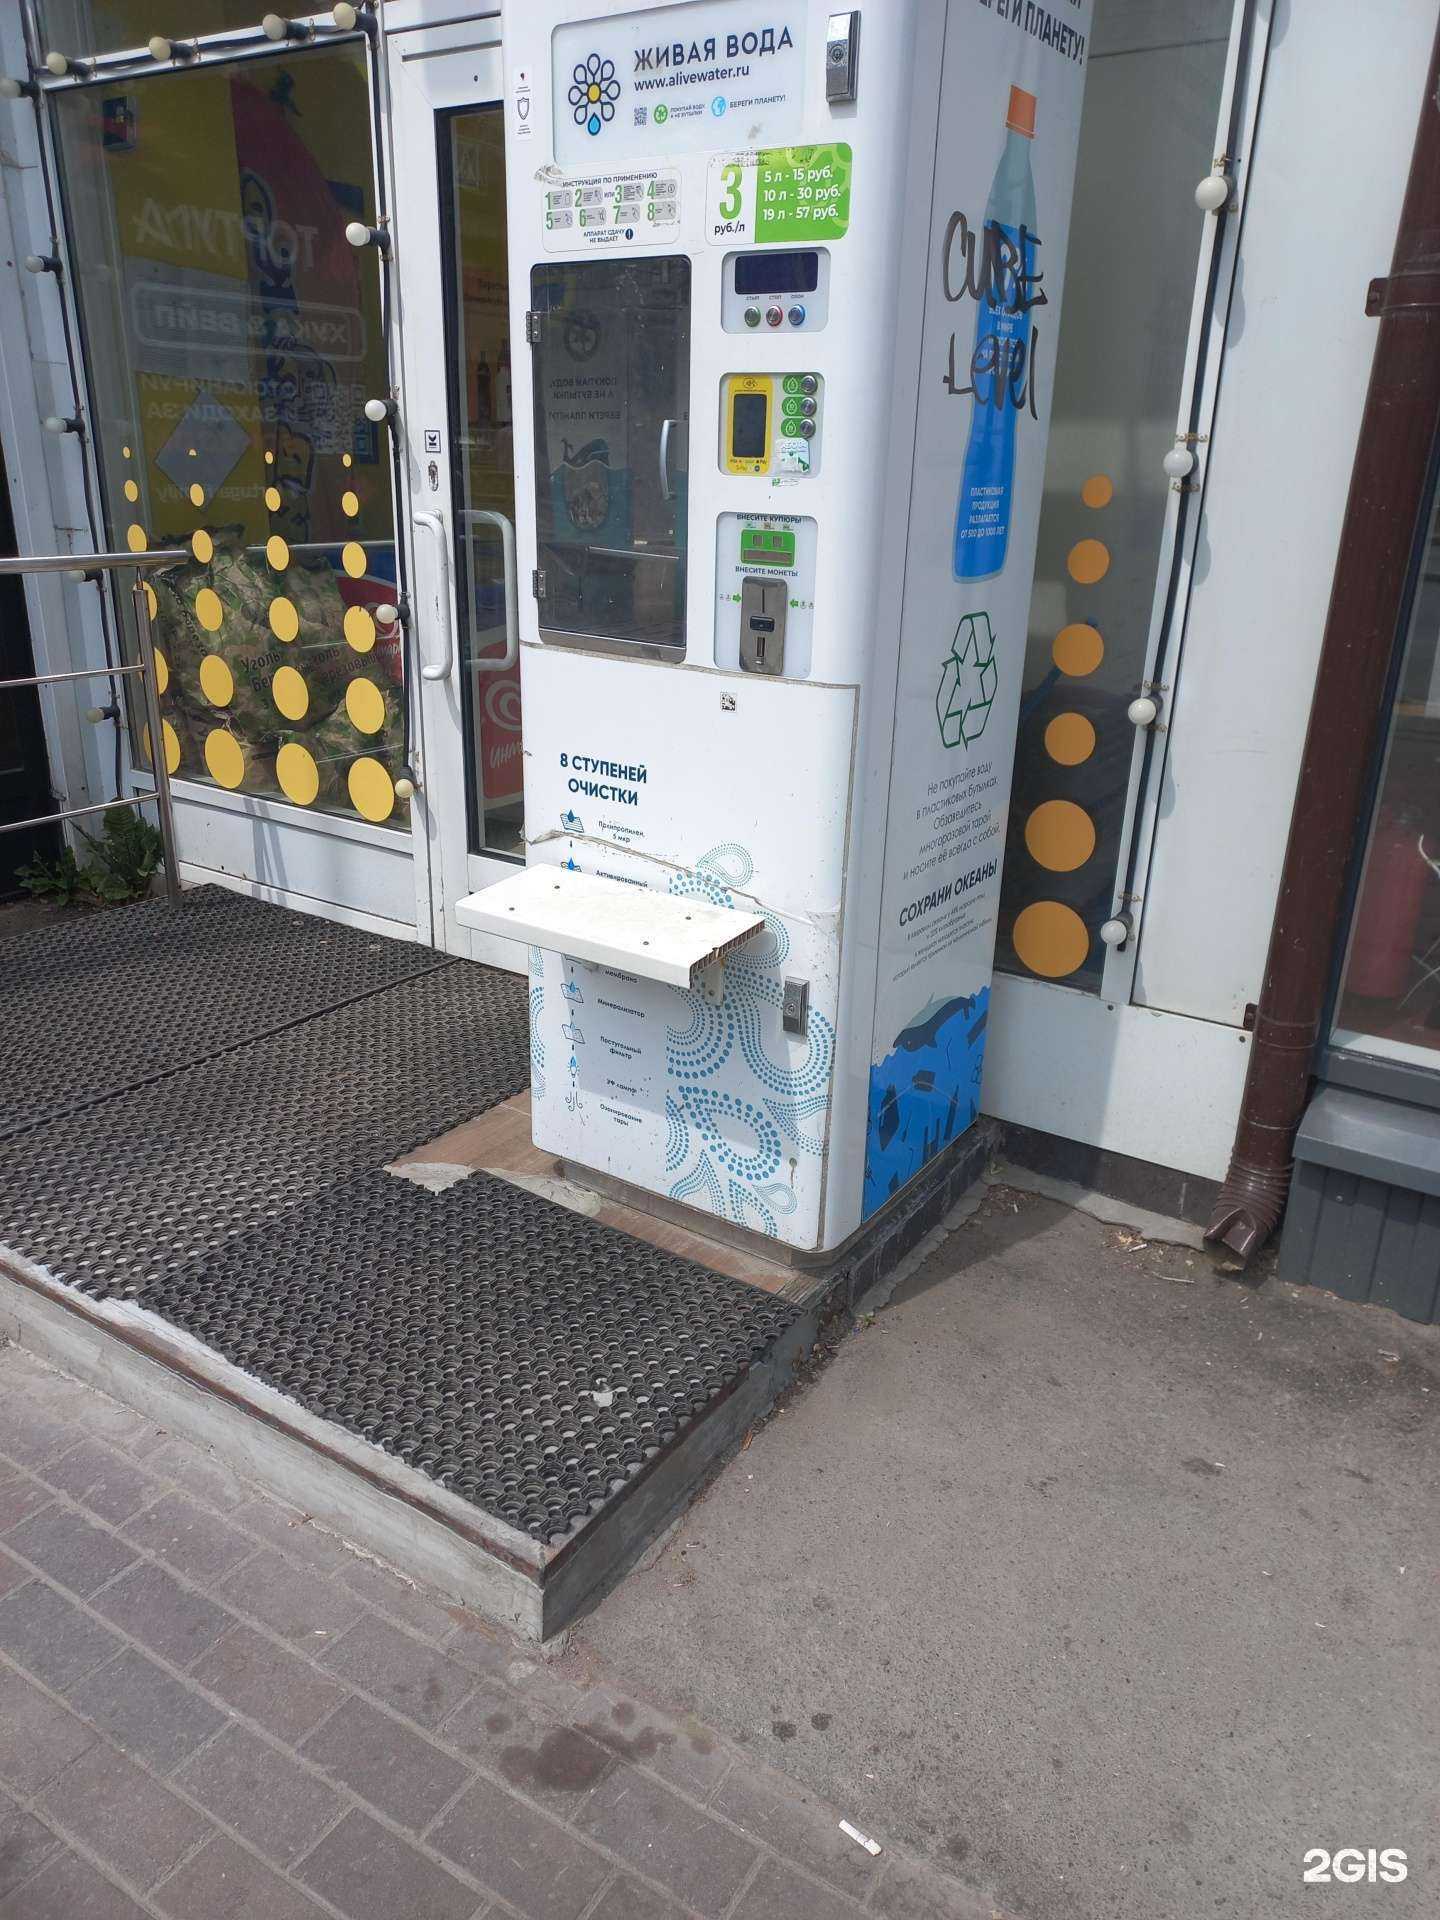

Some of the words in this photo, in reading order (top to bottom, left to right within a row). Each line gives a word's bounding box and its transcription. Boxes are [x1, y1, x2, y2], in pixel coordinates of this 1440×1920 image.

[1025, 0, 1085, 65] ПЛАНЕТУ!
[634, 37, 716, 72] ЖИВАЯ
[727, 26, 793, 57] ВОДА
[634, 65, 750, 91] www.alivewater.ru
[729, 98, 753, 109] БЕРЕГИ
[754, 95, 786, 105] ПЛАНЕТУ!
[562, 178, 601, 188] ИНСТРУКЦИЯ
[613, 172, 657, 183] ПРИМЕНЕНИЮ
[764, 171, 771, 183] 5
[773, 172, 783, 182] л
[792, 168, 805, 181] 15
[807, 165, 833, 183] руб.
[575, 188, 582, 208] 2
[614, 184, 623, 203] 3
[646, 180, 656, 199] 4
[720, 163, 742, 220] 3
[763, 189, 776, 202] 10
[778, 191, 787, 201] л
[797, 187, 812, 200] 30
[815, 184, 841, 201] руб.
[545, 211, 553, 230] 5
[579, 208, 587, 227] 6
[613, 205, 621, 224] 7
[647, 202, 655, 221] 8
[762, 208, 775, 221] 19
[776, 210, 785, 220] л
[795, 206, 810, 219] 57
[813, 204, 839, 221] руб.
[583, 229, 607, 238] АППАРАТ
[714, 220, 745, 236] руб./л
[736, 513, 768, 522] ВНЕСИТЕ
[769, 515, 802, 524] КУПЮРЫ
[735, 565, 766, 575] ВНЕСИТЕ
[767, 568, 798, 577] МОНЕТЫ
[240, 650, 281, 672] Уголь
[560, 753, 568, 767] 8
[572, 755, 647, 783] СТУПЕНЕЙ
[927, 781, 938, 797] Не
[939, 767, 976, 791] покупайте
[977, 760, 992, 776] воду
[568, 778, 638, 806] ОЧИСТКИ
[922, 790, 967, 817] пластиковых
[933, 802, 982, 830] Обзаведитесь
[919, 822, 971, 856] многоразовой
[910, 856, 937, 878] носите
[948, 838, 972, 858] всегда
[596, 869, 648, 888] Активированный
[899, 883, 953, 927] СОХРАНИ
[955, 859, 998, 896] ОКЕАНЫ
[600, 1103, 642, 1124] Озонирование
